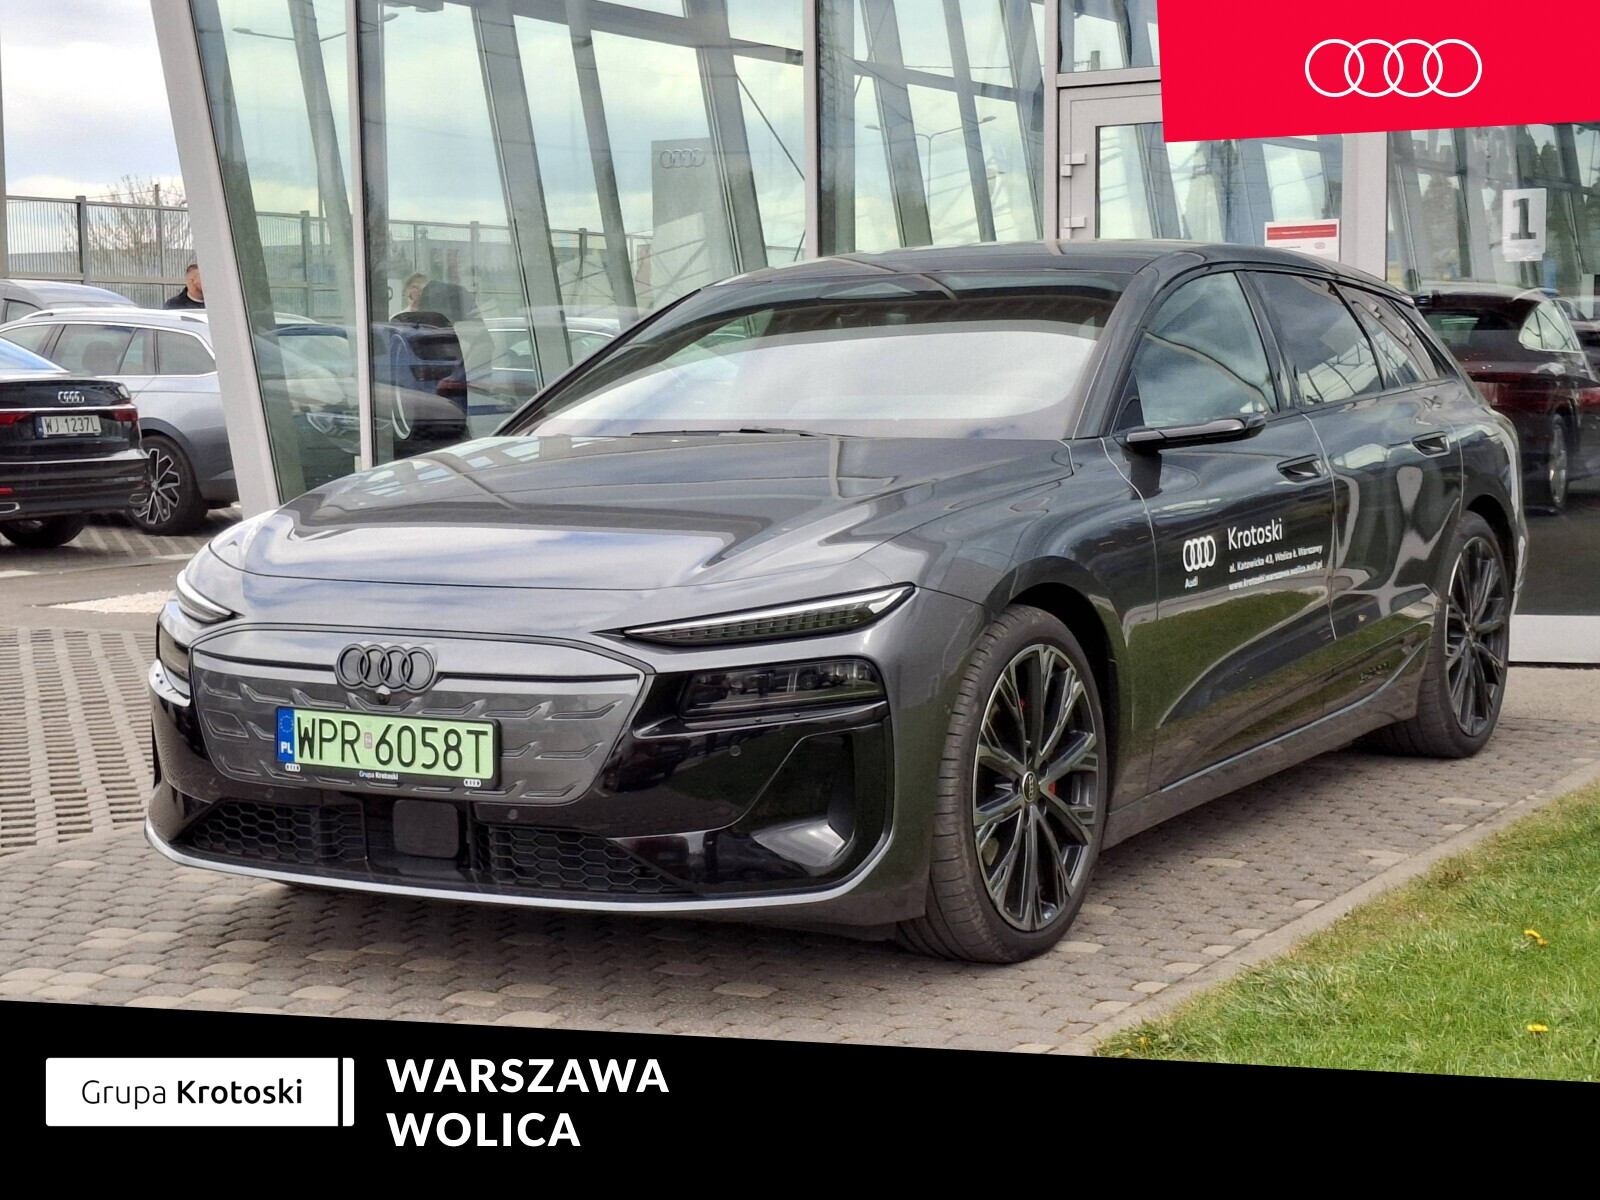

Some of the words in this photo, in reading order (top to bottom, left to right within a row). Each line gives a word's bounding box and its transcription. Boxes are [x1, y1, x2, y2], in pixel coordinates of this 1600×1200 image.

[1511, 198, 1536, 240] 1
[44, 418, 60, 433] WJ
[65, 416, 99, 432] 1237L
[1227, 518, 1283, 550] Krotoski
[281, 742, 293, 754] PL
[297, 716, 361, 764] WPR
[375, 723, 489, 774] 6058T
